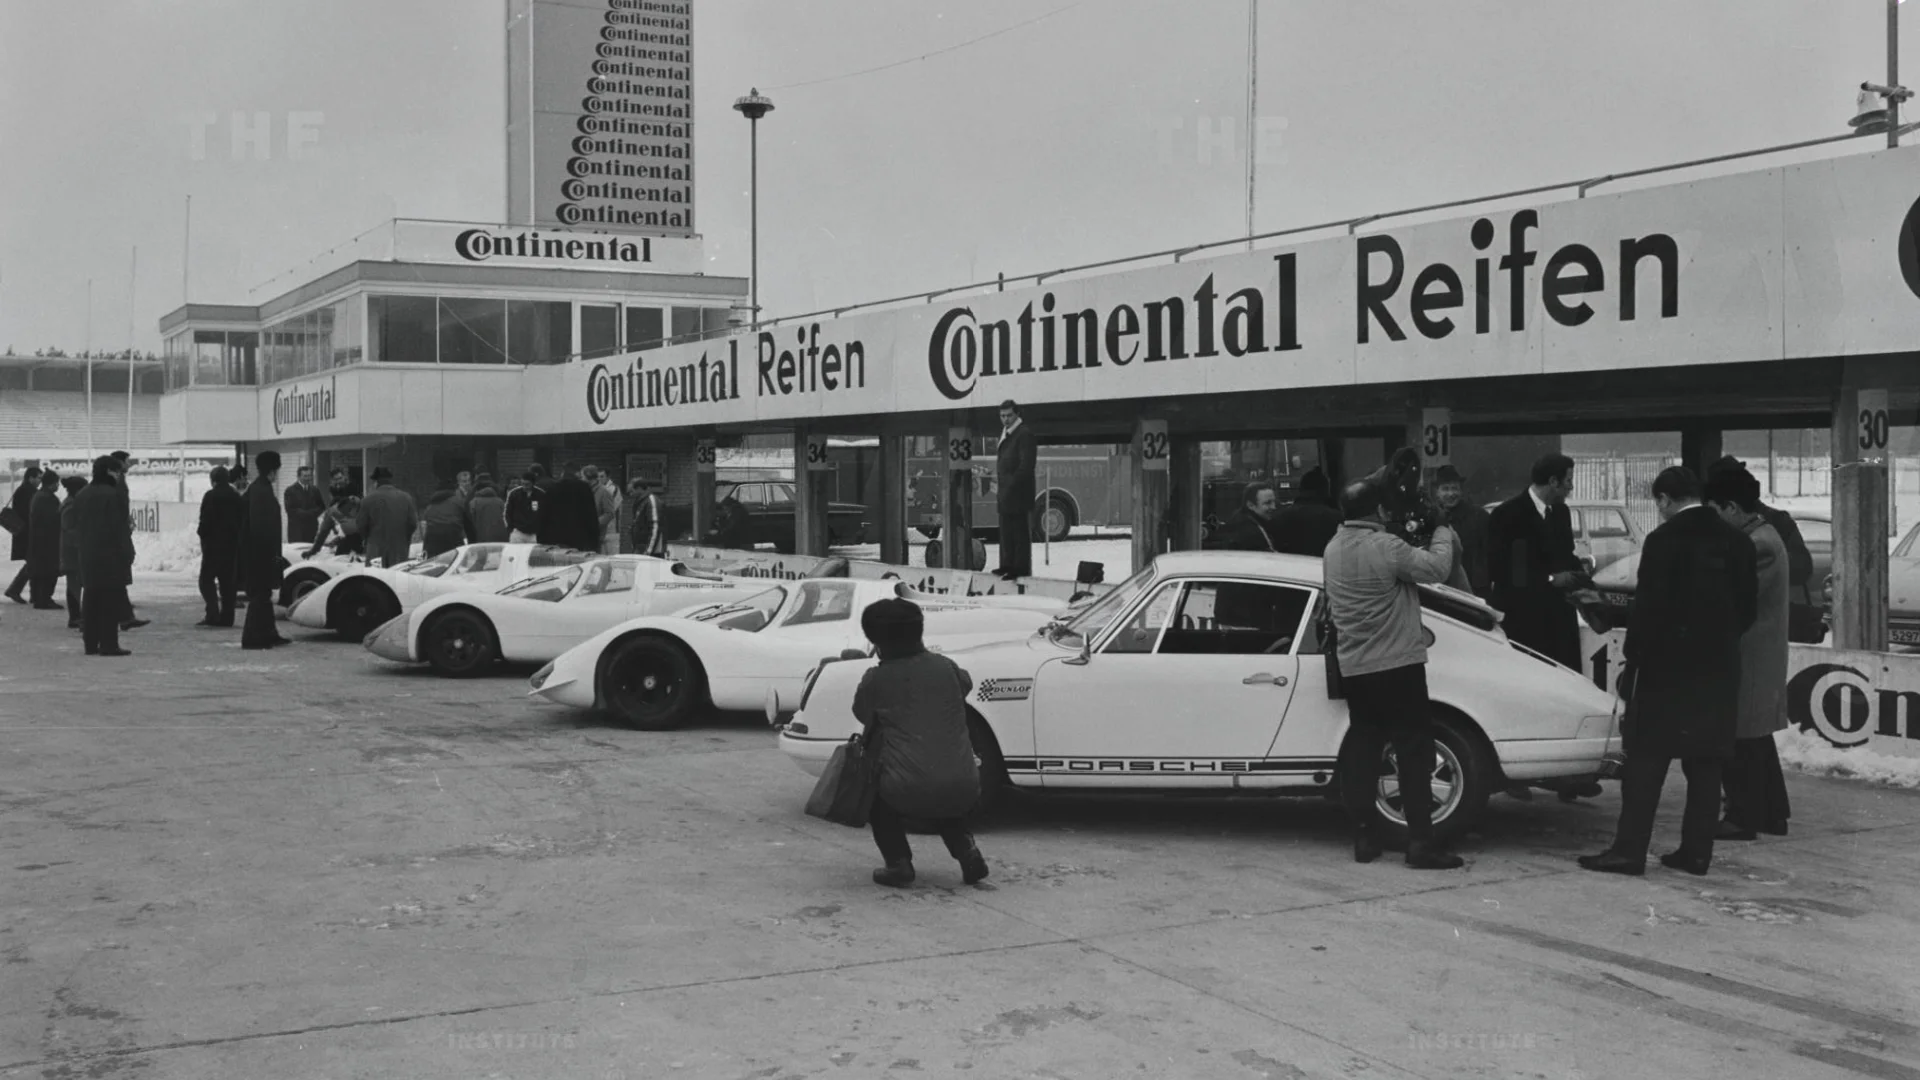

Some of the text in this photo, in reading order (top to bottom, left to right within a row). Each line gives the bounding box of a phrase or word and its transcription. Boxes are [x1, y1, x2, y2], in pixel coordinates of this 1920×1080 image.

[604, 10, 690, 30] Continental
[600, 26, 690, 46] Continental
[595, 42, 691, 63] Continental
[591, 59, 691, 81] Continental
[587, 77, 691, 99] Continental
[582, 96, 691, 118] Continental
[577, 114, 691, 138] Continental
[571, 135, 691, 159] Continental
[566, 156, 691, 181] Continental
[561, 179, 691, 203] Continental
[556, 203, 692, 228] Continental
[453, 229, 650, 262] Continental
[928, 209, 1678, 400] Continental Reifen
[586, 322, 865, 425] Continental Reifen
[273, 375, 336, 435] Continental
[1424, 424, 1449, 456] 31
[1859, 409, 1889, 450] 30
[698, 446, 715, 464] 35
[808, 443, 827, 463] 34
[950, 439, 972, 461] 33
[1144, 432, 1168, 458] 32
[994, 685, 1031, 693] DUNLOP
[1038, 760, 1251, 772] PORSCHE
